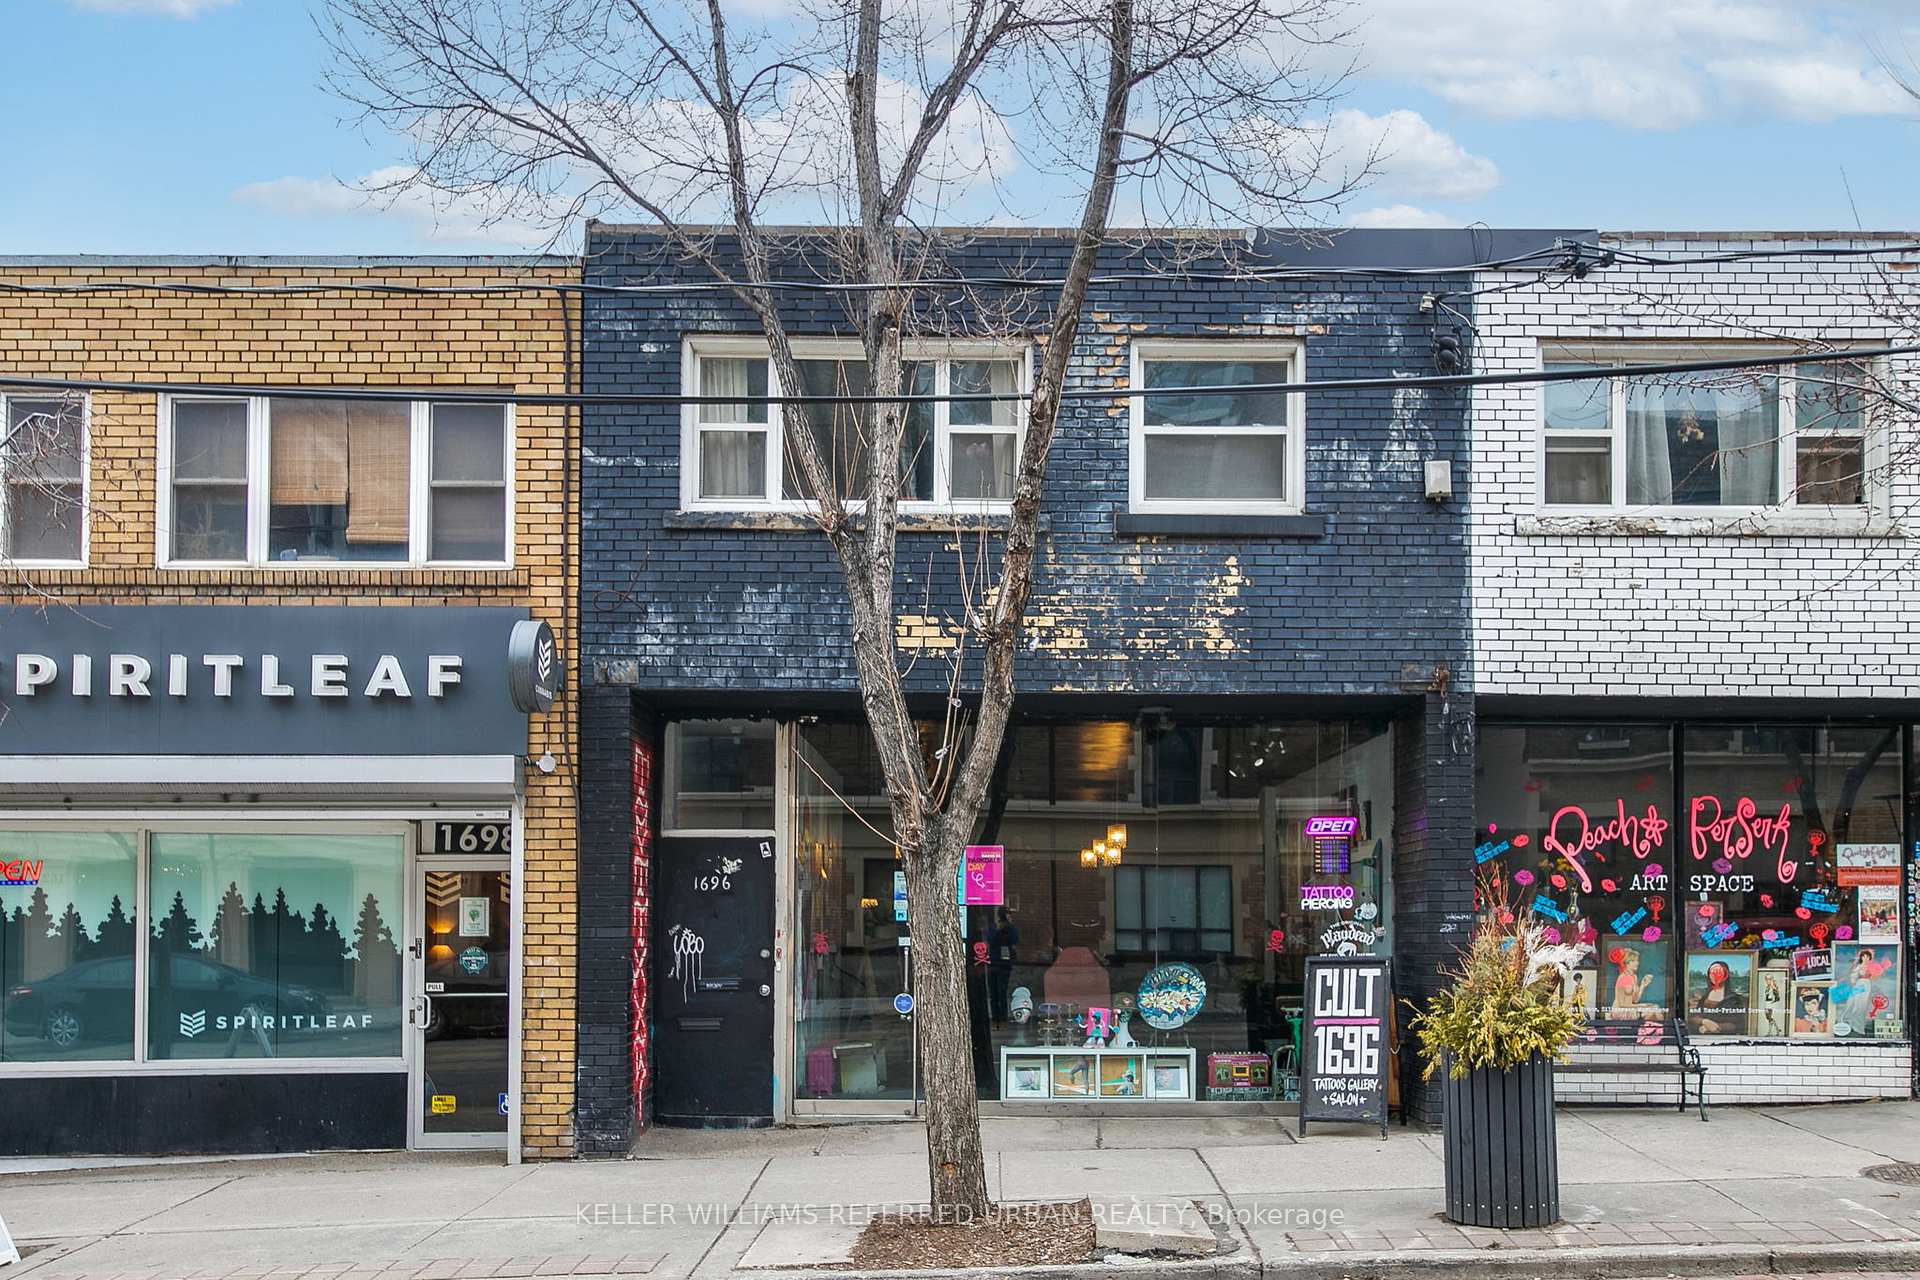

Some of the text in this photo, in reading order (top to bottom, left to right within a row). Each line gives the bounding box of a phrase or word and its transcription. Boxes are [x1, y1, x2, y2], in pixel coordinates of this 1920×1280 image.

[1310, 820, 1354, 832] OPEN
[1544, 798, 1650, 893] Peach
[967, 863, 985, 871] DAY
[694, 875, 731, 891] 1696
[1630, 874, 1754, 892] ART SPACE
[1301, 886, 1354, 899] TATTOO
[1301, 898, 1353, 910] PIERCING
[1807, 954, 1831, 969] LOCAL
[1314, 968, 1382, 1017] CULT
[216, 1015, 373, 1029] SPIRITLEAF
[1313, 1025, 1380, 1075] 1696
[1312, 1077, 1379, 1092] TATTOOS GALLERY
[1329, 1092, 1359, 1107] SALON
